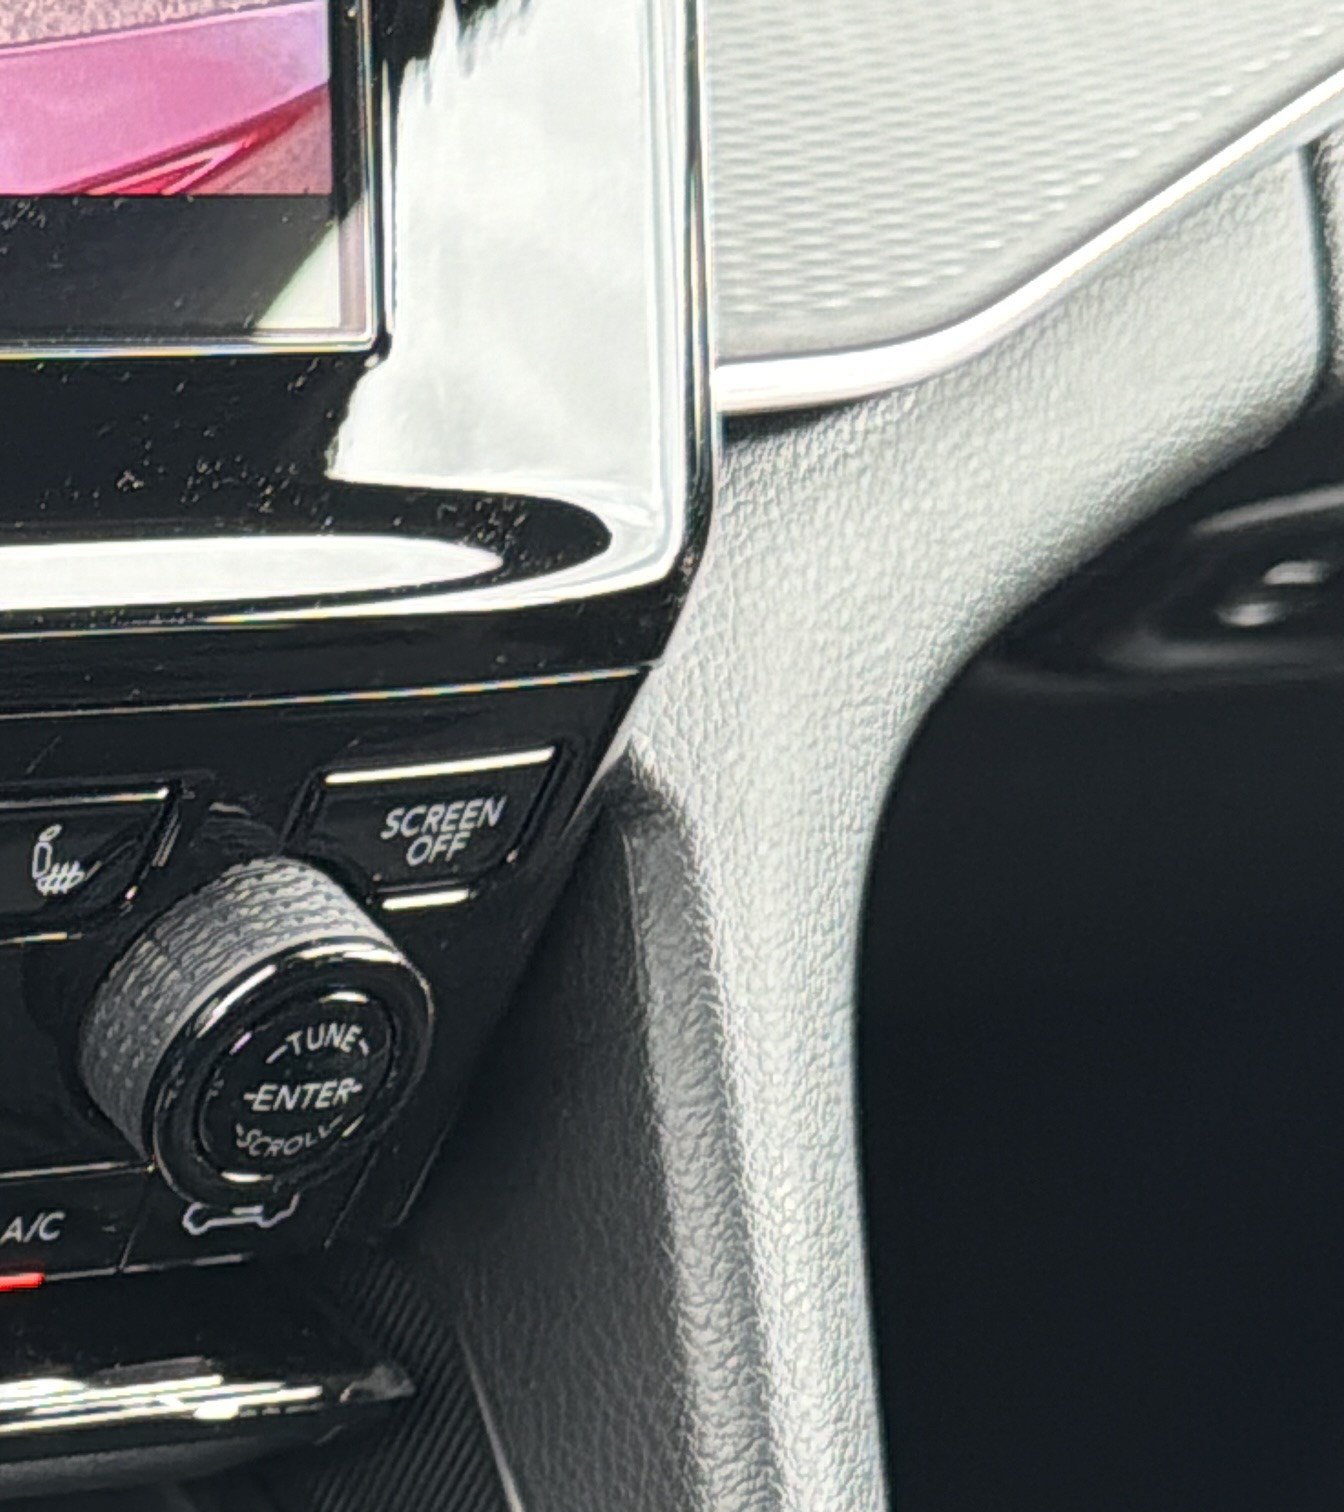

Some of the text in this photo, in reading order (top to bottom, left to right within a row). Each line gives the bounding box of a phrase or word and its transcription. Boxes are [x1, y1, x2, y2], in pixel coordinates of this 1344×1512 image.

[380, 797, 507, 840] SCREEN
[405, 831, 470, 867] OFF
[284, 1022, 362, 1056] TUNE
[250, 1077, 358, 1112] ENTER
[235, 1124, 333, 1158] SCROLL
